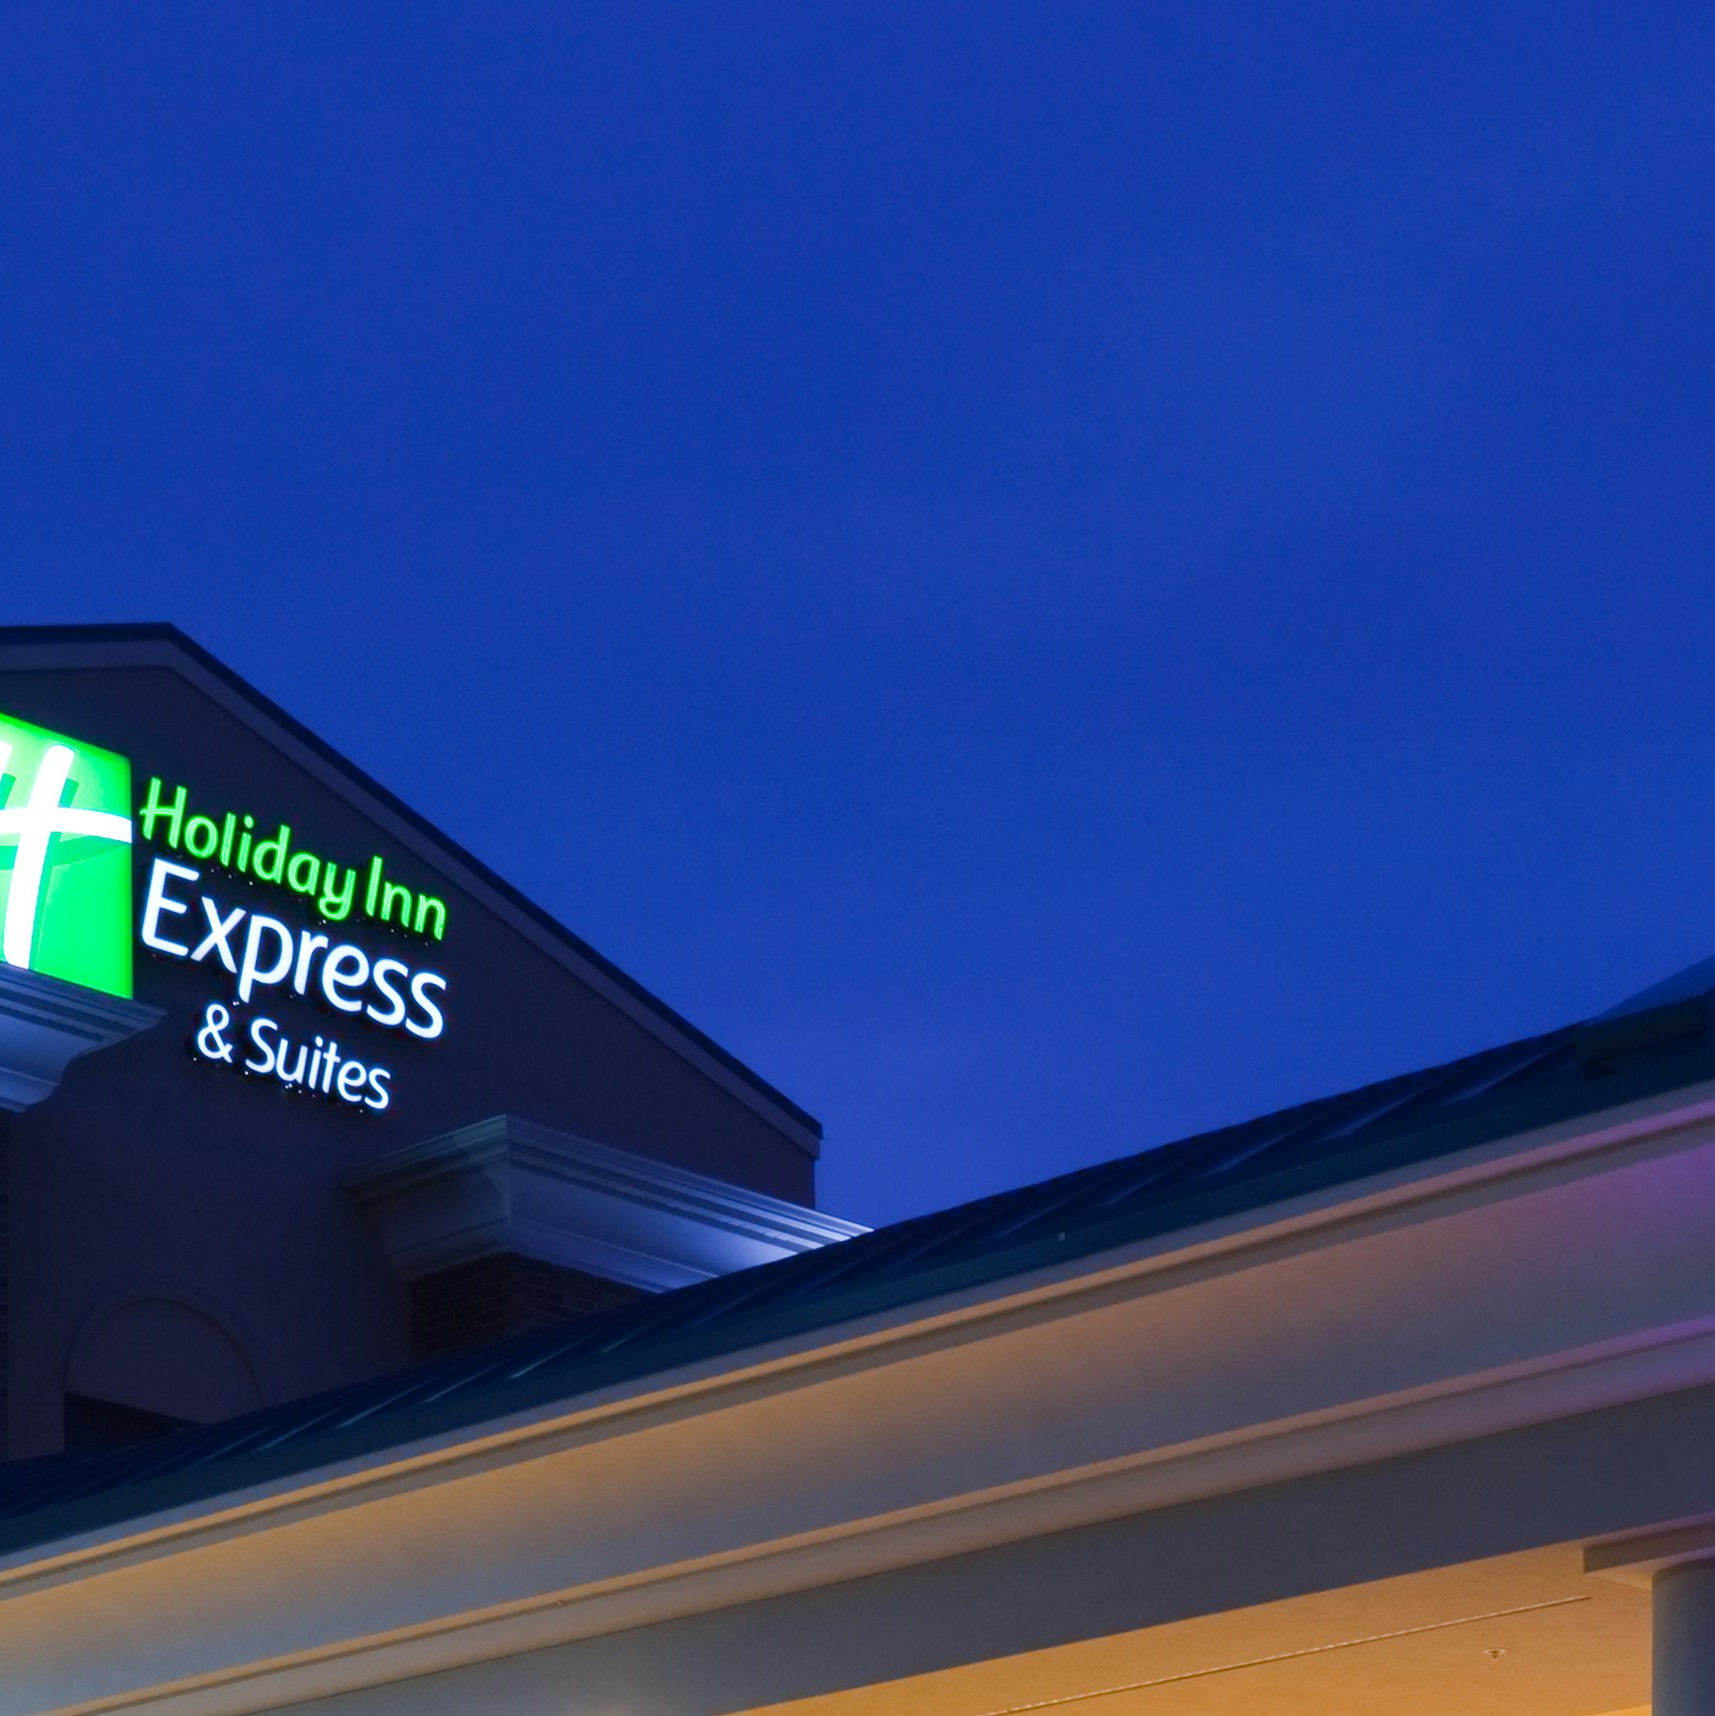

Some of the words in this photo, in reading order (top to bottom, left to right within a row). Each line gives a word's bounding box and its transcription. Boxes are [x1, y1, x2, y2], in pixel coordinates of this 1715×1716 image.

[139, 776, 357, 922] Holiday
[364, 855, 448, 941] Inn
[141, 857, 448, 1040] Express
[196, 1003, 235, 1064] &
[245, 1017, 392, 1110] Suites
